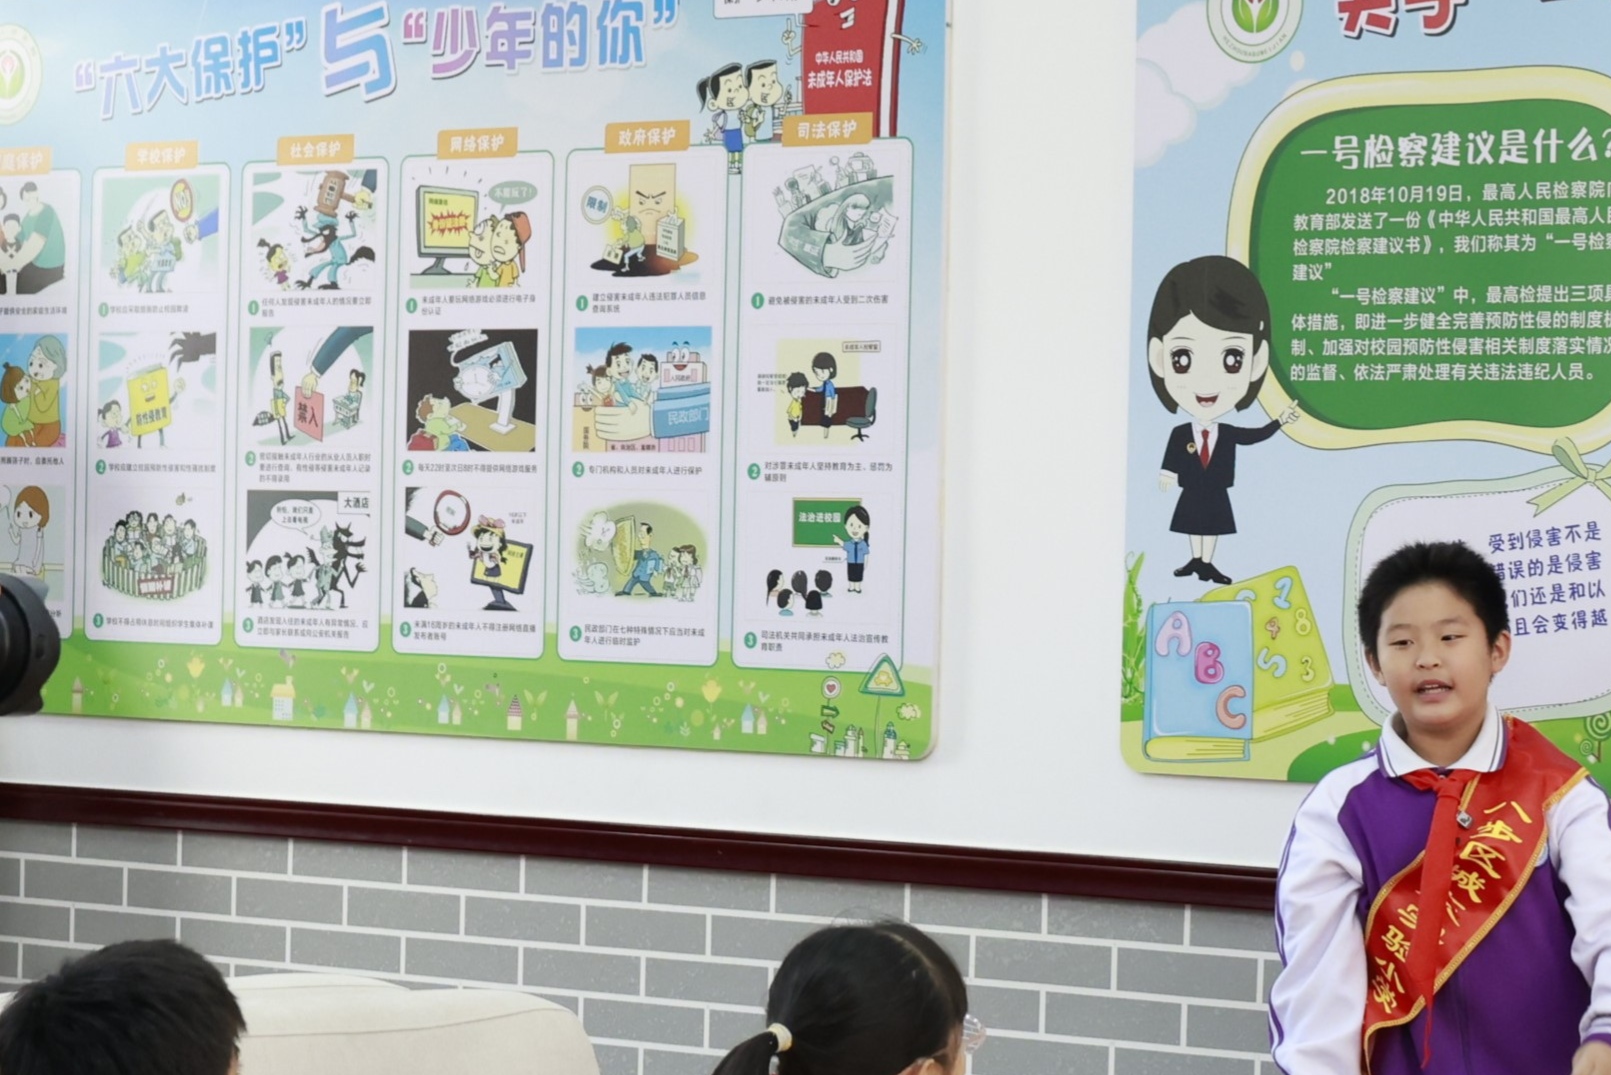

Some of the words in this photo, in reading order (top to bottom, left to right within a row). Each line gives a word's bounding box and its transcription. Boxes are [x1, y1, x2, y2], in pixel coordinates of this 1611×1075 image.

[815, 51, 864, 64] 中华人民共和国
[807, 69, 873, 88] 未成年人保护法
[619, 128, 677, 147] 政府保护
[798, 120, 858, 140] 司法保护
[290, 140, 342, 159] 社会保护
[450, 134, 505, 153] 网络保护
[137, 144, 187, 164] 学校保护
[586, 194, 608, 215] 限制
[1292, 262, 1332, 282] 建议”
[1290, 362, 1595, 383] 的监督、依法严肃处理有关违法违纪人员。
[668, 408, 710, 426] 民政部门
[798, 510, 842, 524] 法治进校园
[1488, 520, 1602, 554] 受到侵害不是
[1505, 581, 1606, 610] 们还是和以
[1295, 608, 1311, 636] 8
[1155, 610, 1192, 657] A
[1194, 641, 1225, 684] B
[1301, 656, 1315, 682] 3
[1215, 684, 1247, 730] C
